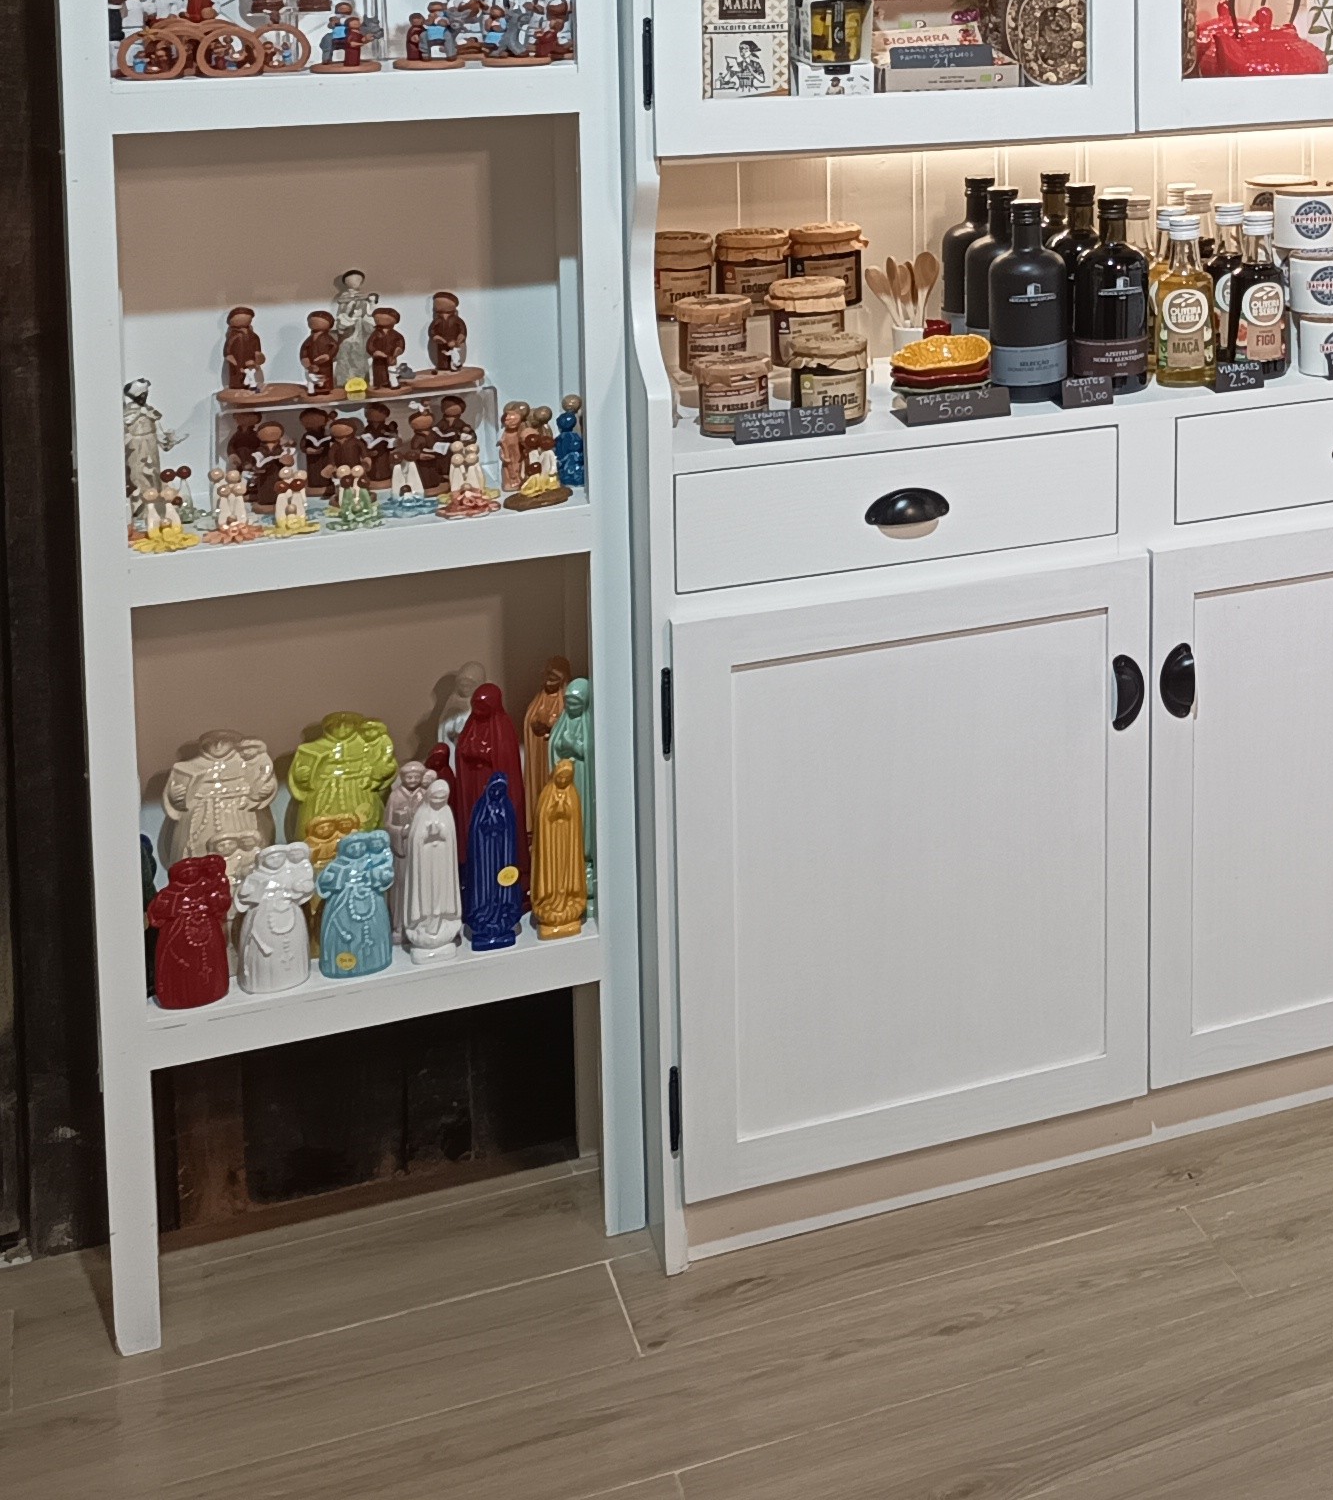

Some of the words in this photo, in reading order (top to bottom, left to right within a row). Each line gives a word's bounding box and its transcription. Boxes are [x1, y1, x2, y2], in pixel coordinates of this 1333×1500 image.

[883, 33, 950, 46] BIOBARRA
[1250, 299, 1280, 309] OLIVEIRA
[1170, 306, 1201, 316] OLIVEIRA
[1258, 307, 1278, 316] SERRA
[1177, 314, 1200, 323] SERRA
[1256, 333, 1275, 347] FIGO
[1172, 339, 1200, 354] MAÇÃ
[1218, 362, 1259, 374] VINAGRES
[1065, 376, 1105, 387] AZEITES
[1228, 373, 1256, 387] 2.50
[1079, 386, 1108, 403] 15.00
[939, 403, 973, 418] 5.00
[800, 417, 836, 434] 3.80
[750, 428, 781, 440] 3.80
